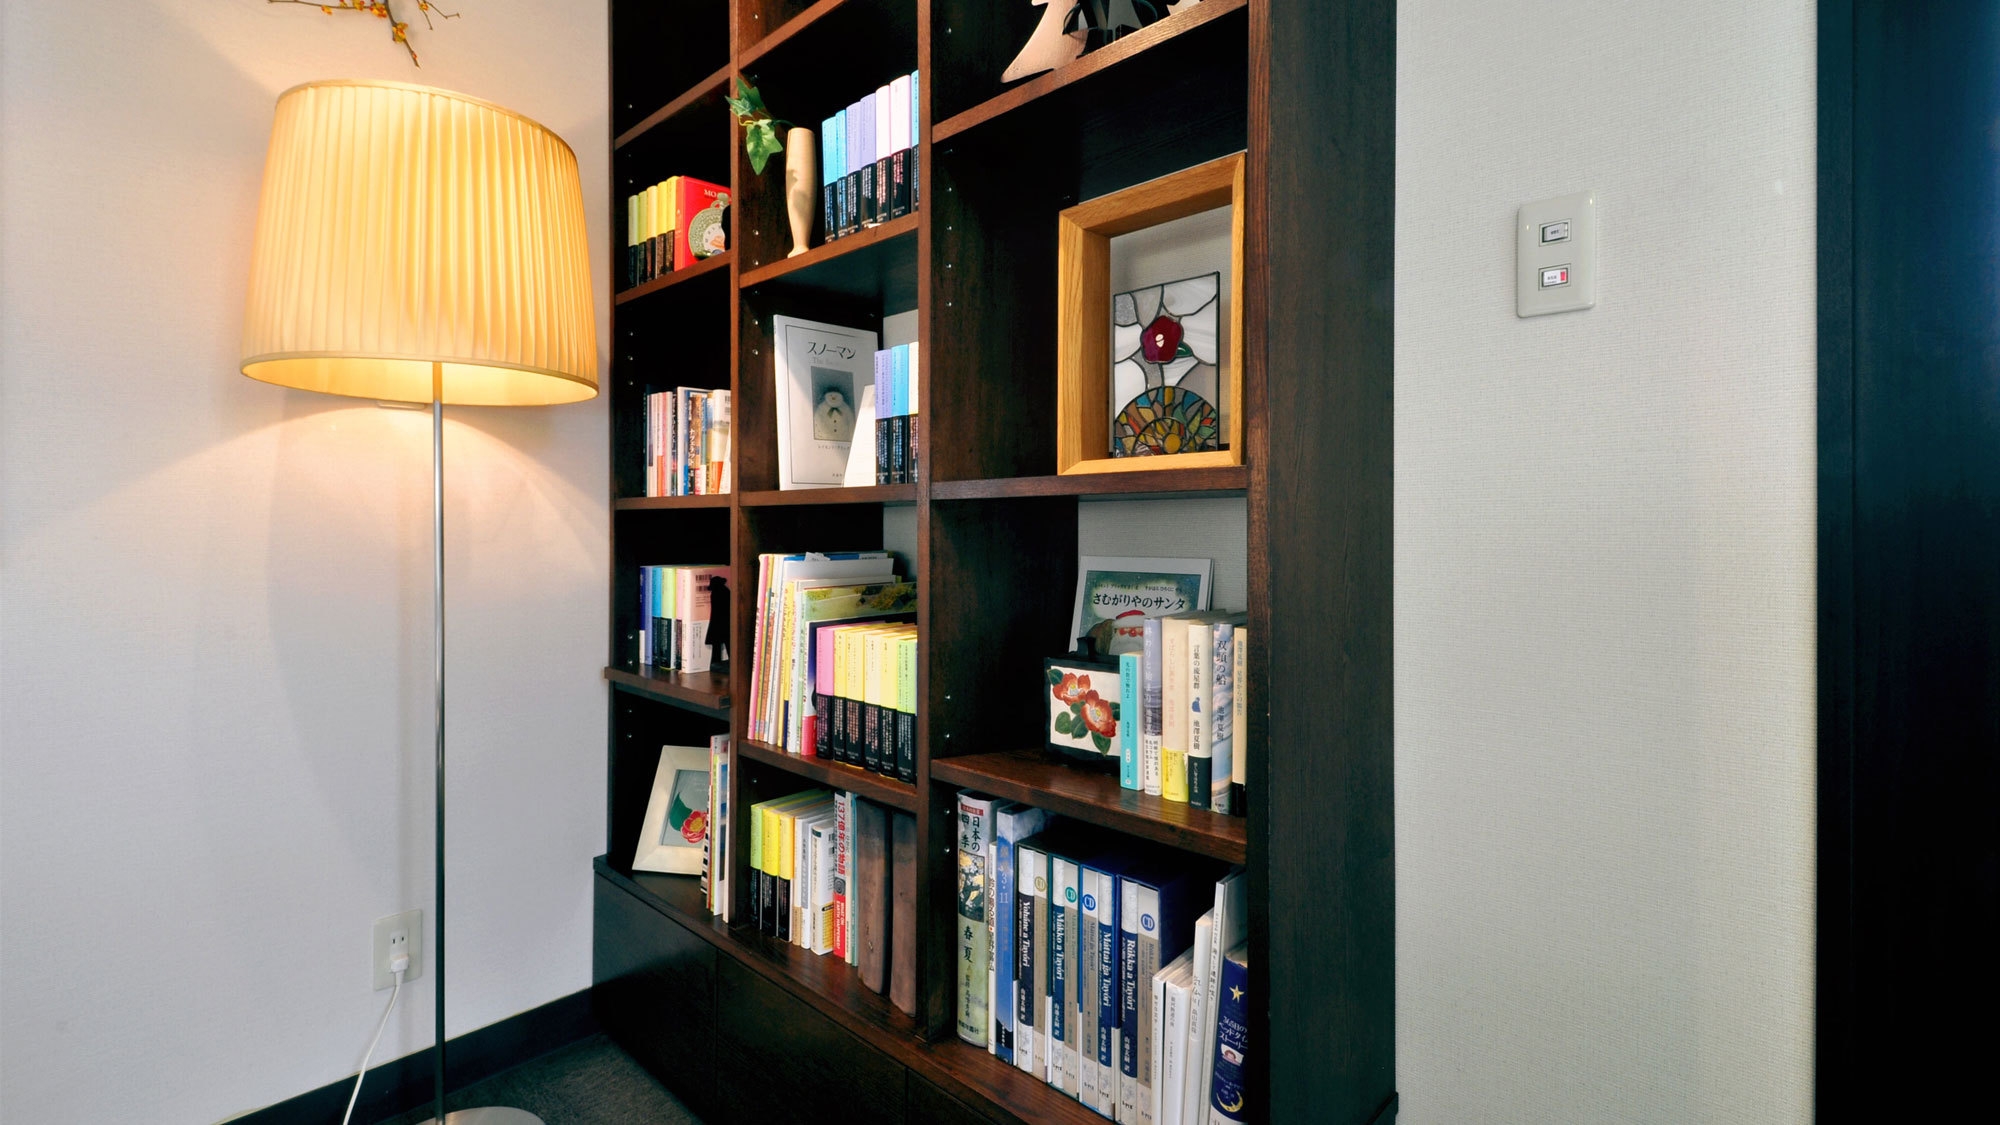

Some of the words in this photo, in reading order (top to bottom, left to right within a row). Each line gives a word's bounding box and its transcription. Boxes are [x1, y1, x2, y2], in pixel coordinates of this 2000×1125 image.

[807, 342, 856, 360] スノーマン
[1093, 593, 1185, 610] さむがりやのサンタ
[1216, 640, 1227, 686] 双頭の船
[836, 802, 846, 876] 137億年の物語
[961, 813, 970, 848] 四季
[971, 816, 982, 852] 日本の
[964, 925, 973, 941] 春
[964, 945, 973, 963] 夏
[1223, 1015, 1248, 1033] 365日の
